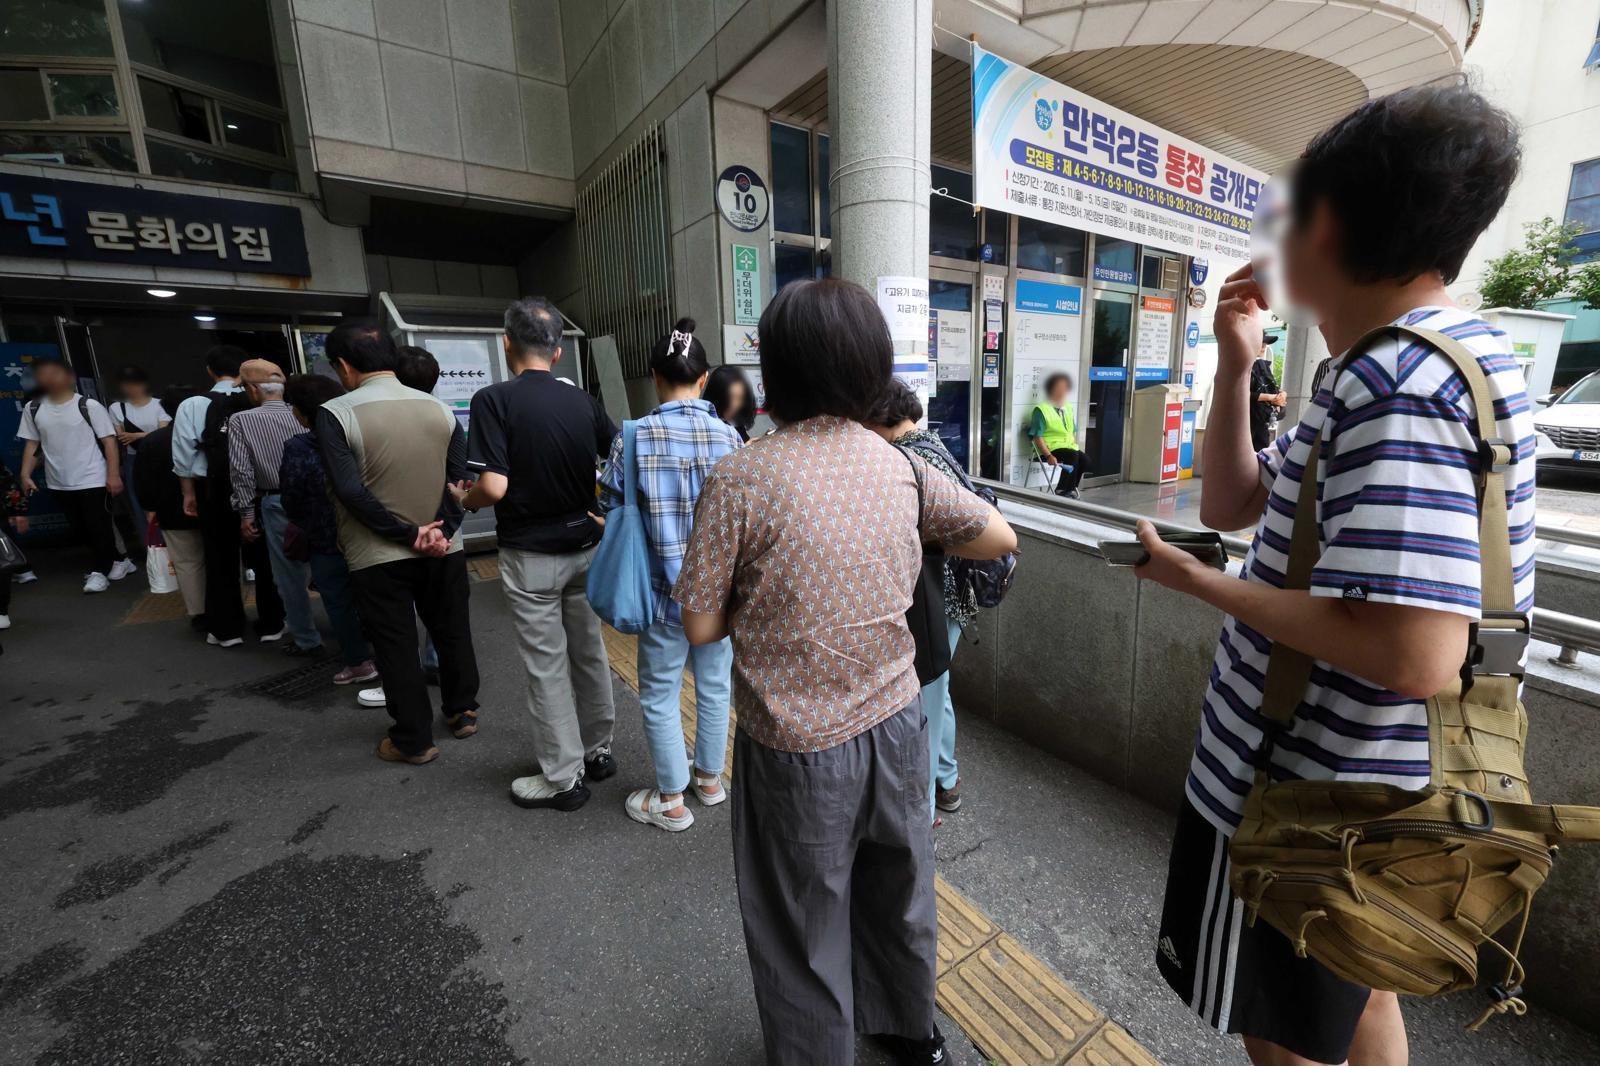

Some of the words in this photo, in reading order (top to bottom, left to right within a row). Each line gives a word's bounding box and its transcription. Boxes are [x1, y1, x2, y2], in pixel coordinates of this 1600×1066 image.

[1026, 146, 1054, 171] 모집통
[1063, 159, 1073, 177] 제
[1063, 100, 1159, 179] 만덕2동
[1165, 144, 1206, 195] 통장
[1210, 162, 1264, 212] 공개모
[1012, 171, 1039, 189] 신청기간
[734, 192, 756, 213] 10
[1011, 189, 1037, 207] 제출서류
[0, 191, 68, 246] 년
[1094, 267, 1133, 282] 무인민원발급창구
[1196, 271, 1203, 281] 10
[741, 271, 752, 297] 무더위
[743, 299, 753, 316] 쉼터
[1055, 298, 1079, 312] 시설안내
